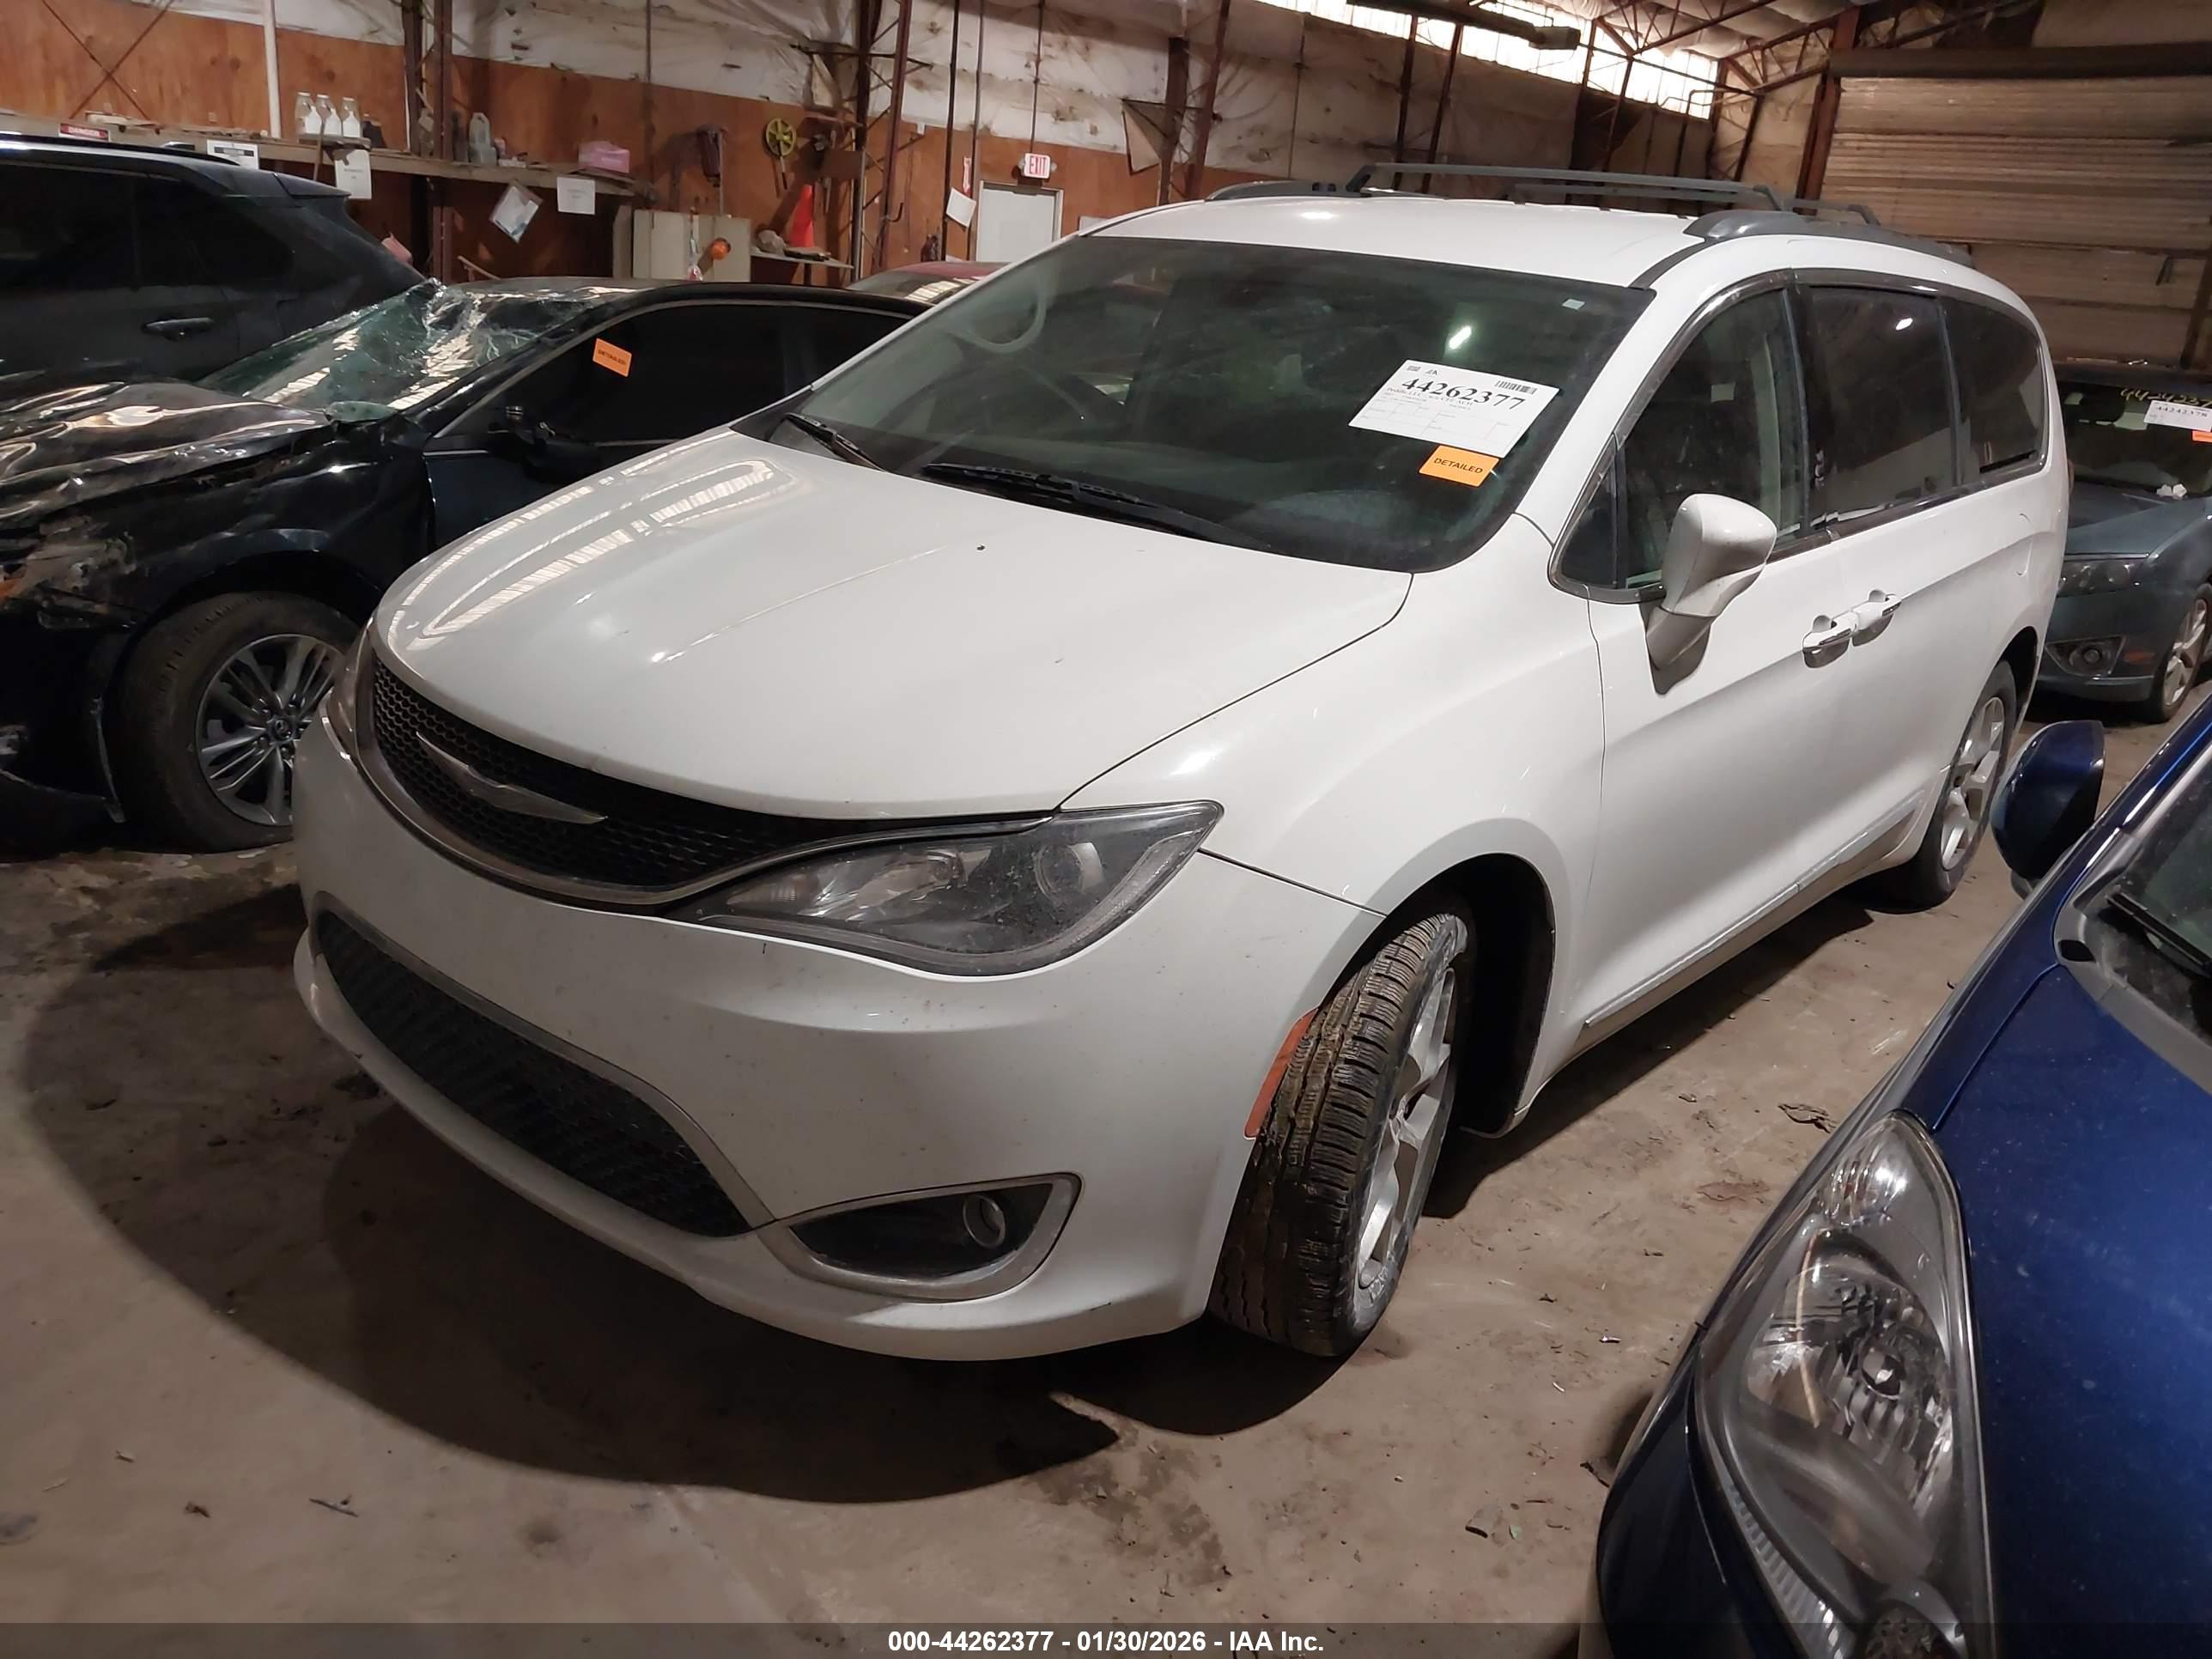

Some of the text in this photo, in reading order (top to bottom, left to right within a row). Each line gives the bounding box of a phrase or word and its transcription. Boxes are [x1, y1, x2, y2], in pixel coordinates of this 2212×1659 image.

[1030, 155, 1047, 177] EXIT
[1401, 378, 1526, 410] 44262377
[1433, 458, 1483, 474] DETAILED
